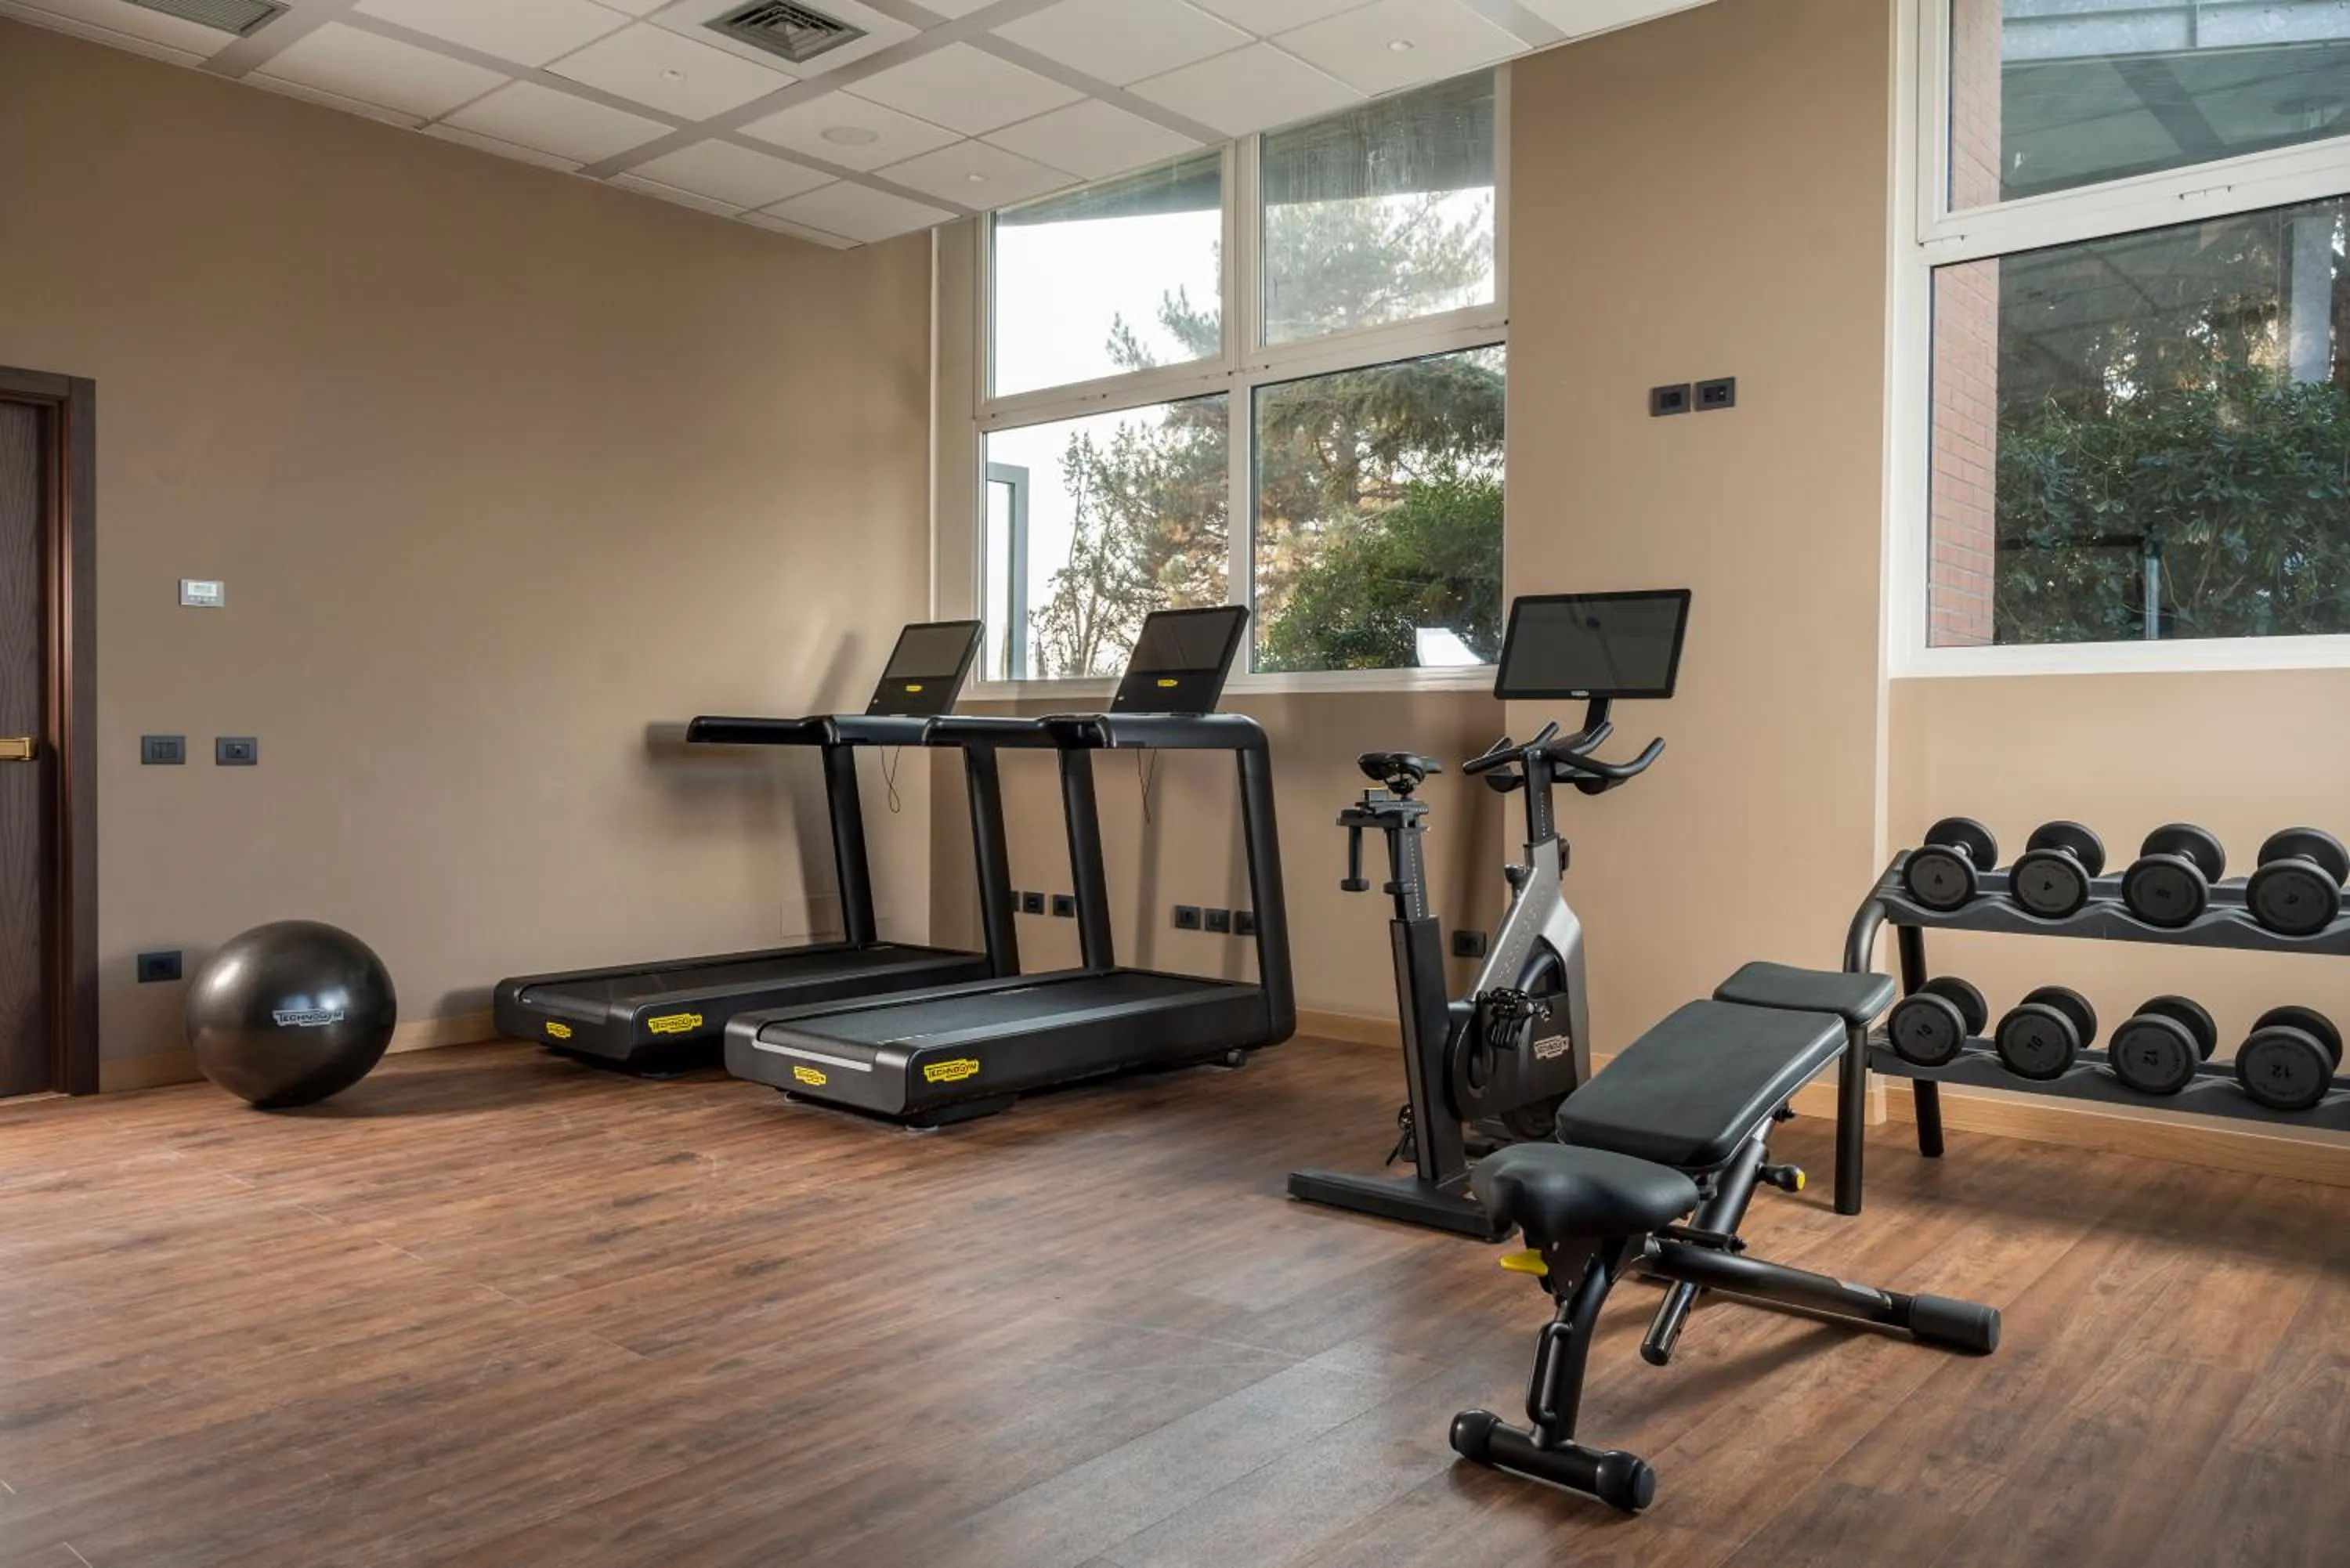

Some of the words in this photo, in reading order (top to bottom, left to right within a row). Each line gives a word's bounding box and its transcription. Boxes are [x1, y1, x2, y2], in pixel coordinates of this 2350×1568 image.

[274, 1010, 343, 1024] TECHNOGYM
[649, 1015, 701, 1031] TECHNOGYM
[2026, 1035, 2044, 1052] 10
[925, 1060, 978, 1080] TECHNOGYM
